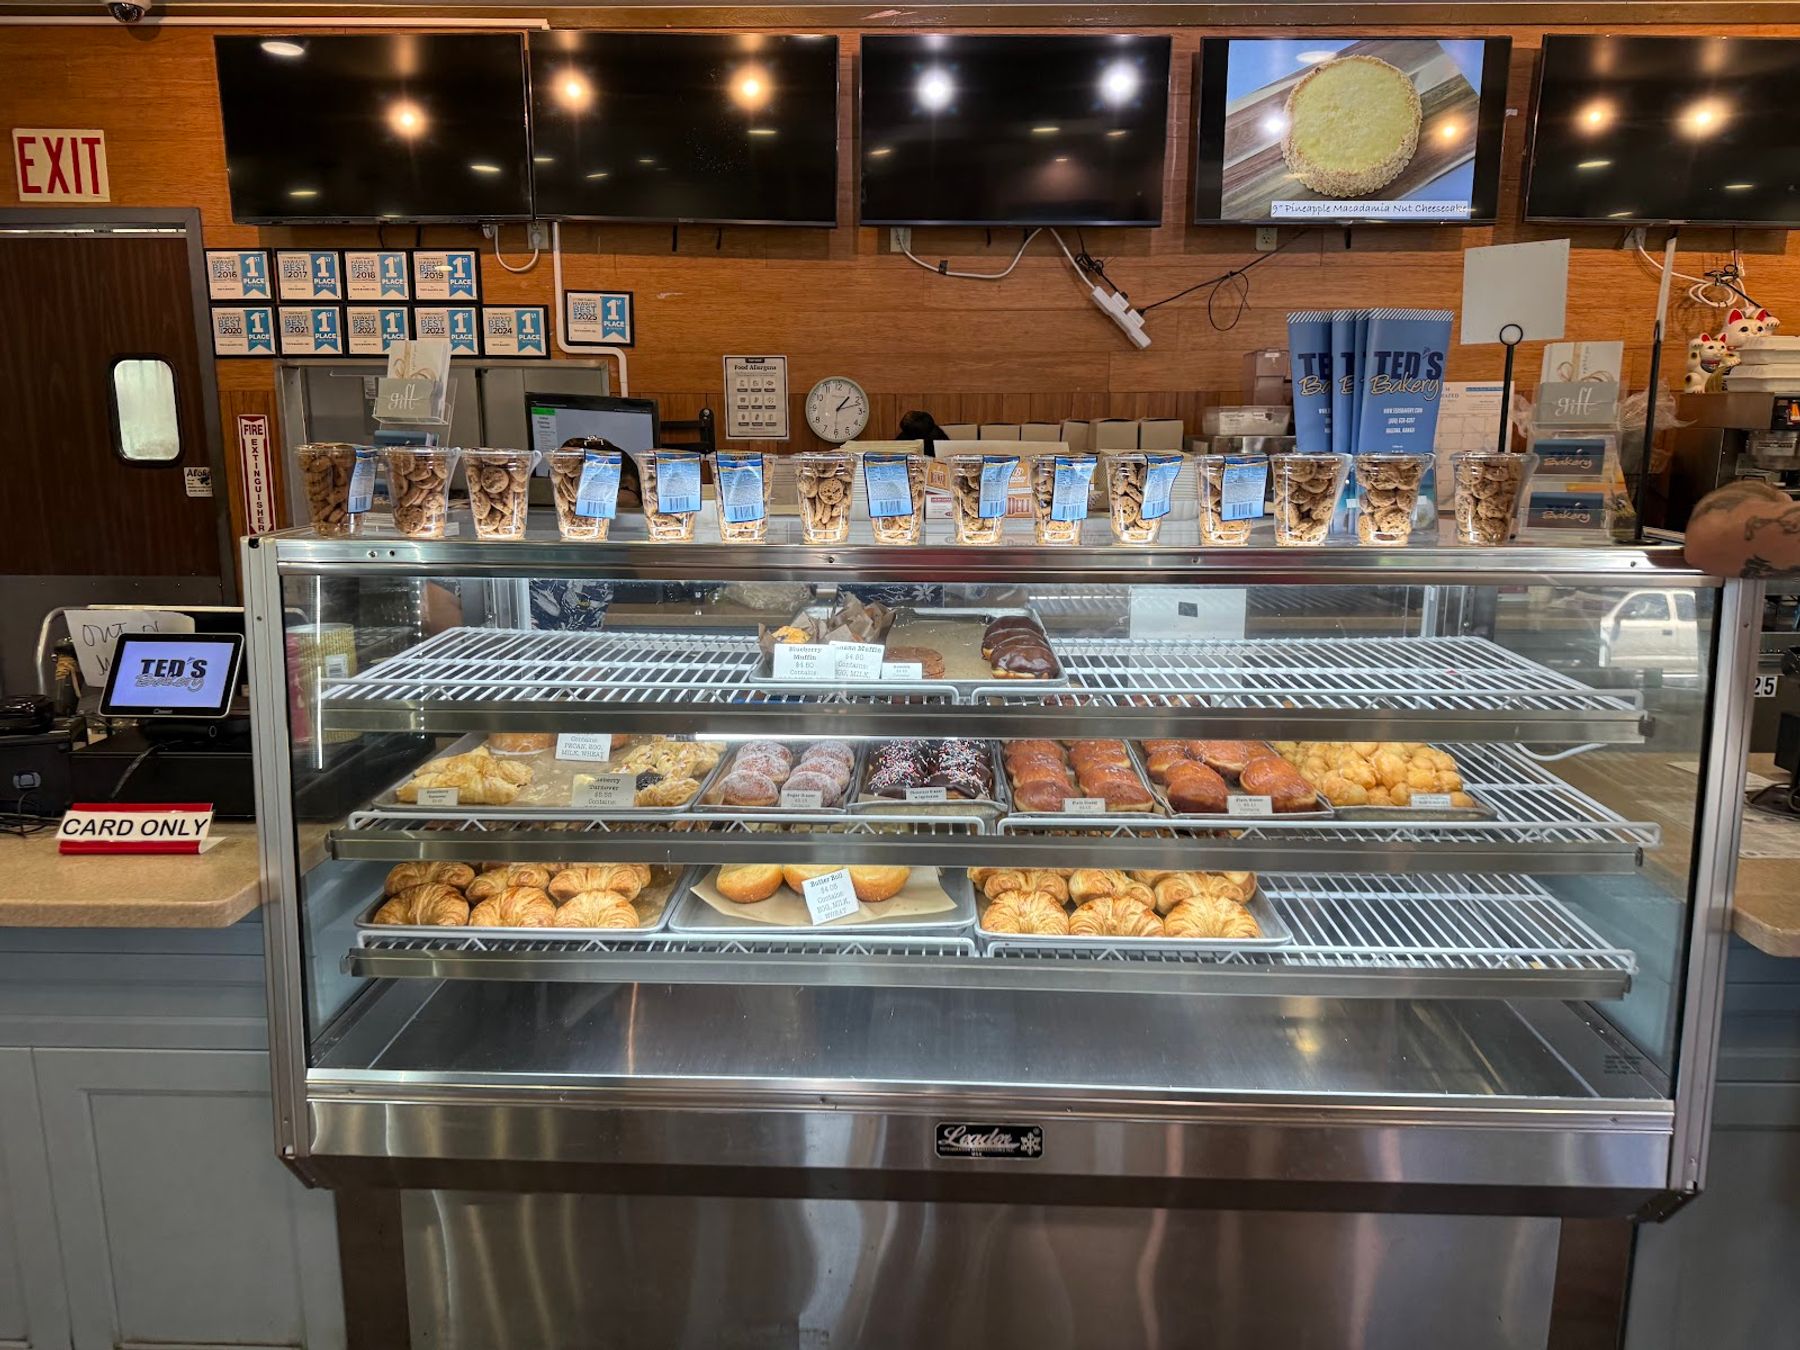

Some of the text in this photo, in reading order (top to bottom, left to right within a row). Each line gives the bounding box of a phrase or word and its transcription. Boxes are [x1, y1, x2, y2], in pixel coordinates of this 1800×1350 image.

[17, 136, 101, 194] EXIT
[1285, 203, 1331, 216] Pineapple
[1333, 203, 1390, 213] Macadamia
[1392, 203, 1412, 213] Nut
[489, 320, 511, 328] BEST
[577, 313, 598, 321] 2025
[604, 320, 624, 328] PLACE
[1373, 346, 1443, 380] TED'S
[388, 383, 421, 410] gift
[1370, 372, 1439, 401] Bakery
[1555, 387, 1599, 417] gift
[244, 424, 264, 436] FIRE
[251, 438, 265, 532] EXTINGUISHER
[82, 622, 127, 647] OUT
[788, 646, 823, 654] Blueberry
[857, 645, 882, 654] Muffin
[140, 656, 208, 678] TED'S
[62, 818, 208, 836] CARD ONLY
[810, 877, 830, 888] Butter
[938, 1125, 1020, 1149] Leader
